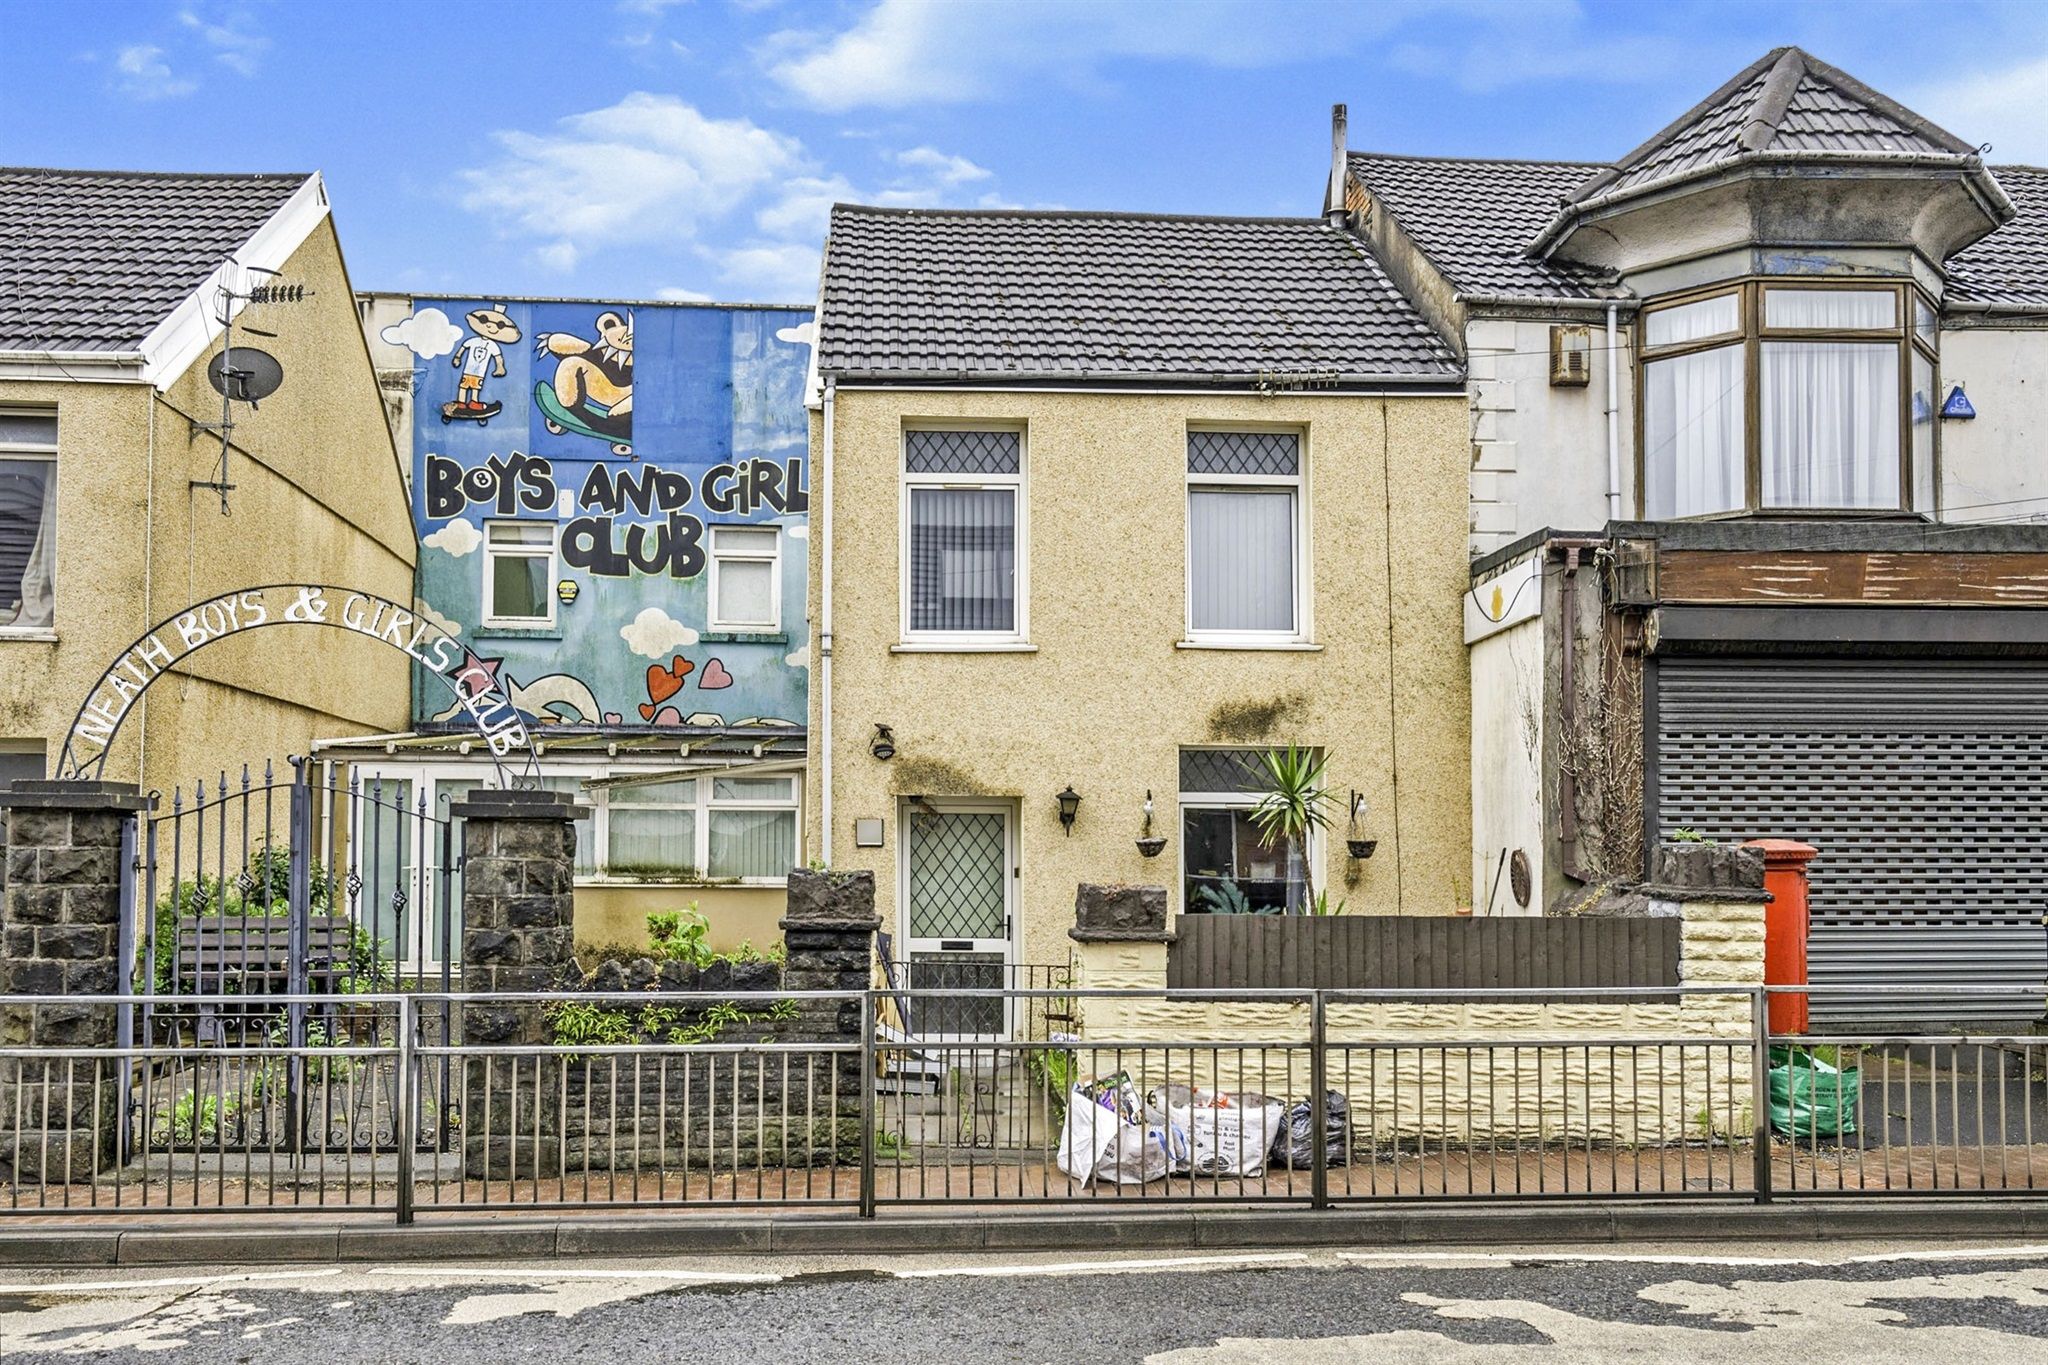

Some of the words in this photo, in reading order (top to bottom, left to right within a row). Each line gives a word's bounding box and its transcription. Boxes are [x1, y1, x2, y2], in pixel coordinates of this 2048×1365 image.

[426, 451, 556, 519] BOYS
[578, 462, 692, 517] AND
[561, 512, 706, 579] CLUB
[74, 634, 174, 746] NEATH
[173, 590, 267, 650] BOYS
[284, 586, 328, 622] &
[343, 593, 461, 674] GIRLS
[454, 668, 527, 756] CLUB
